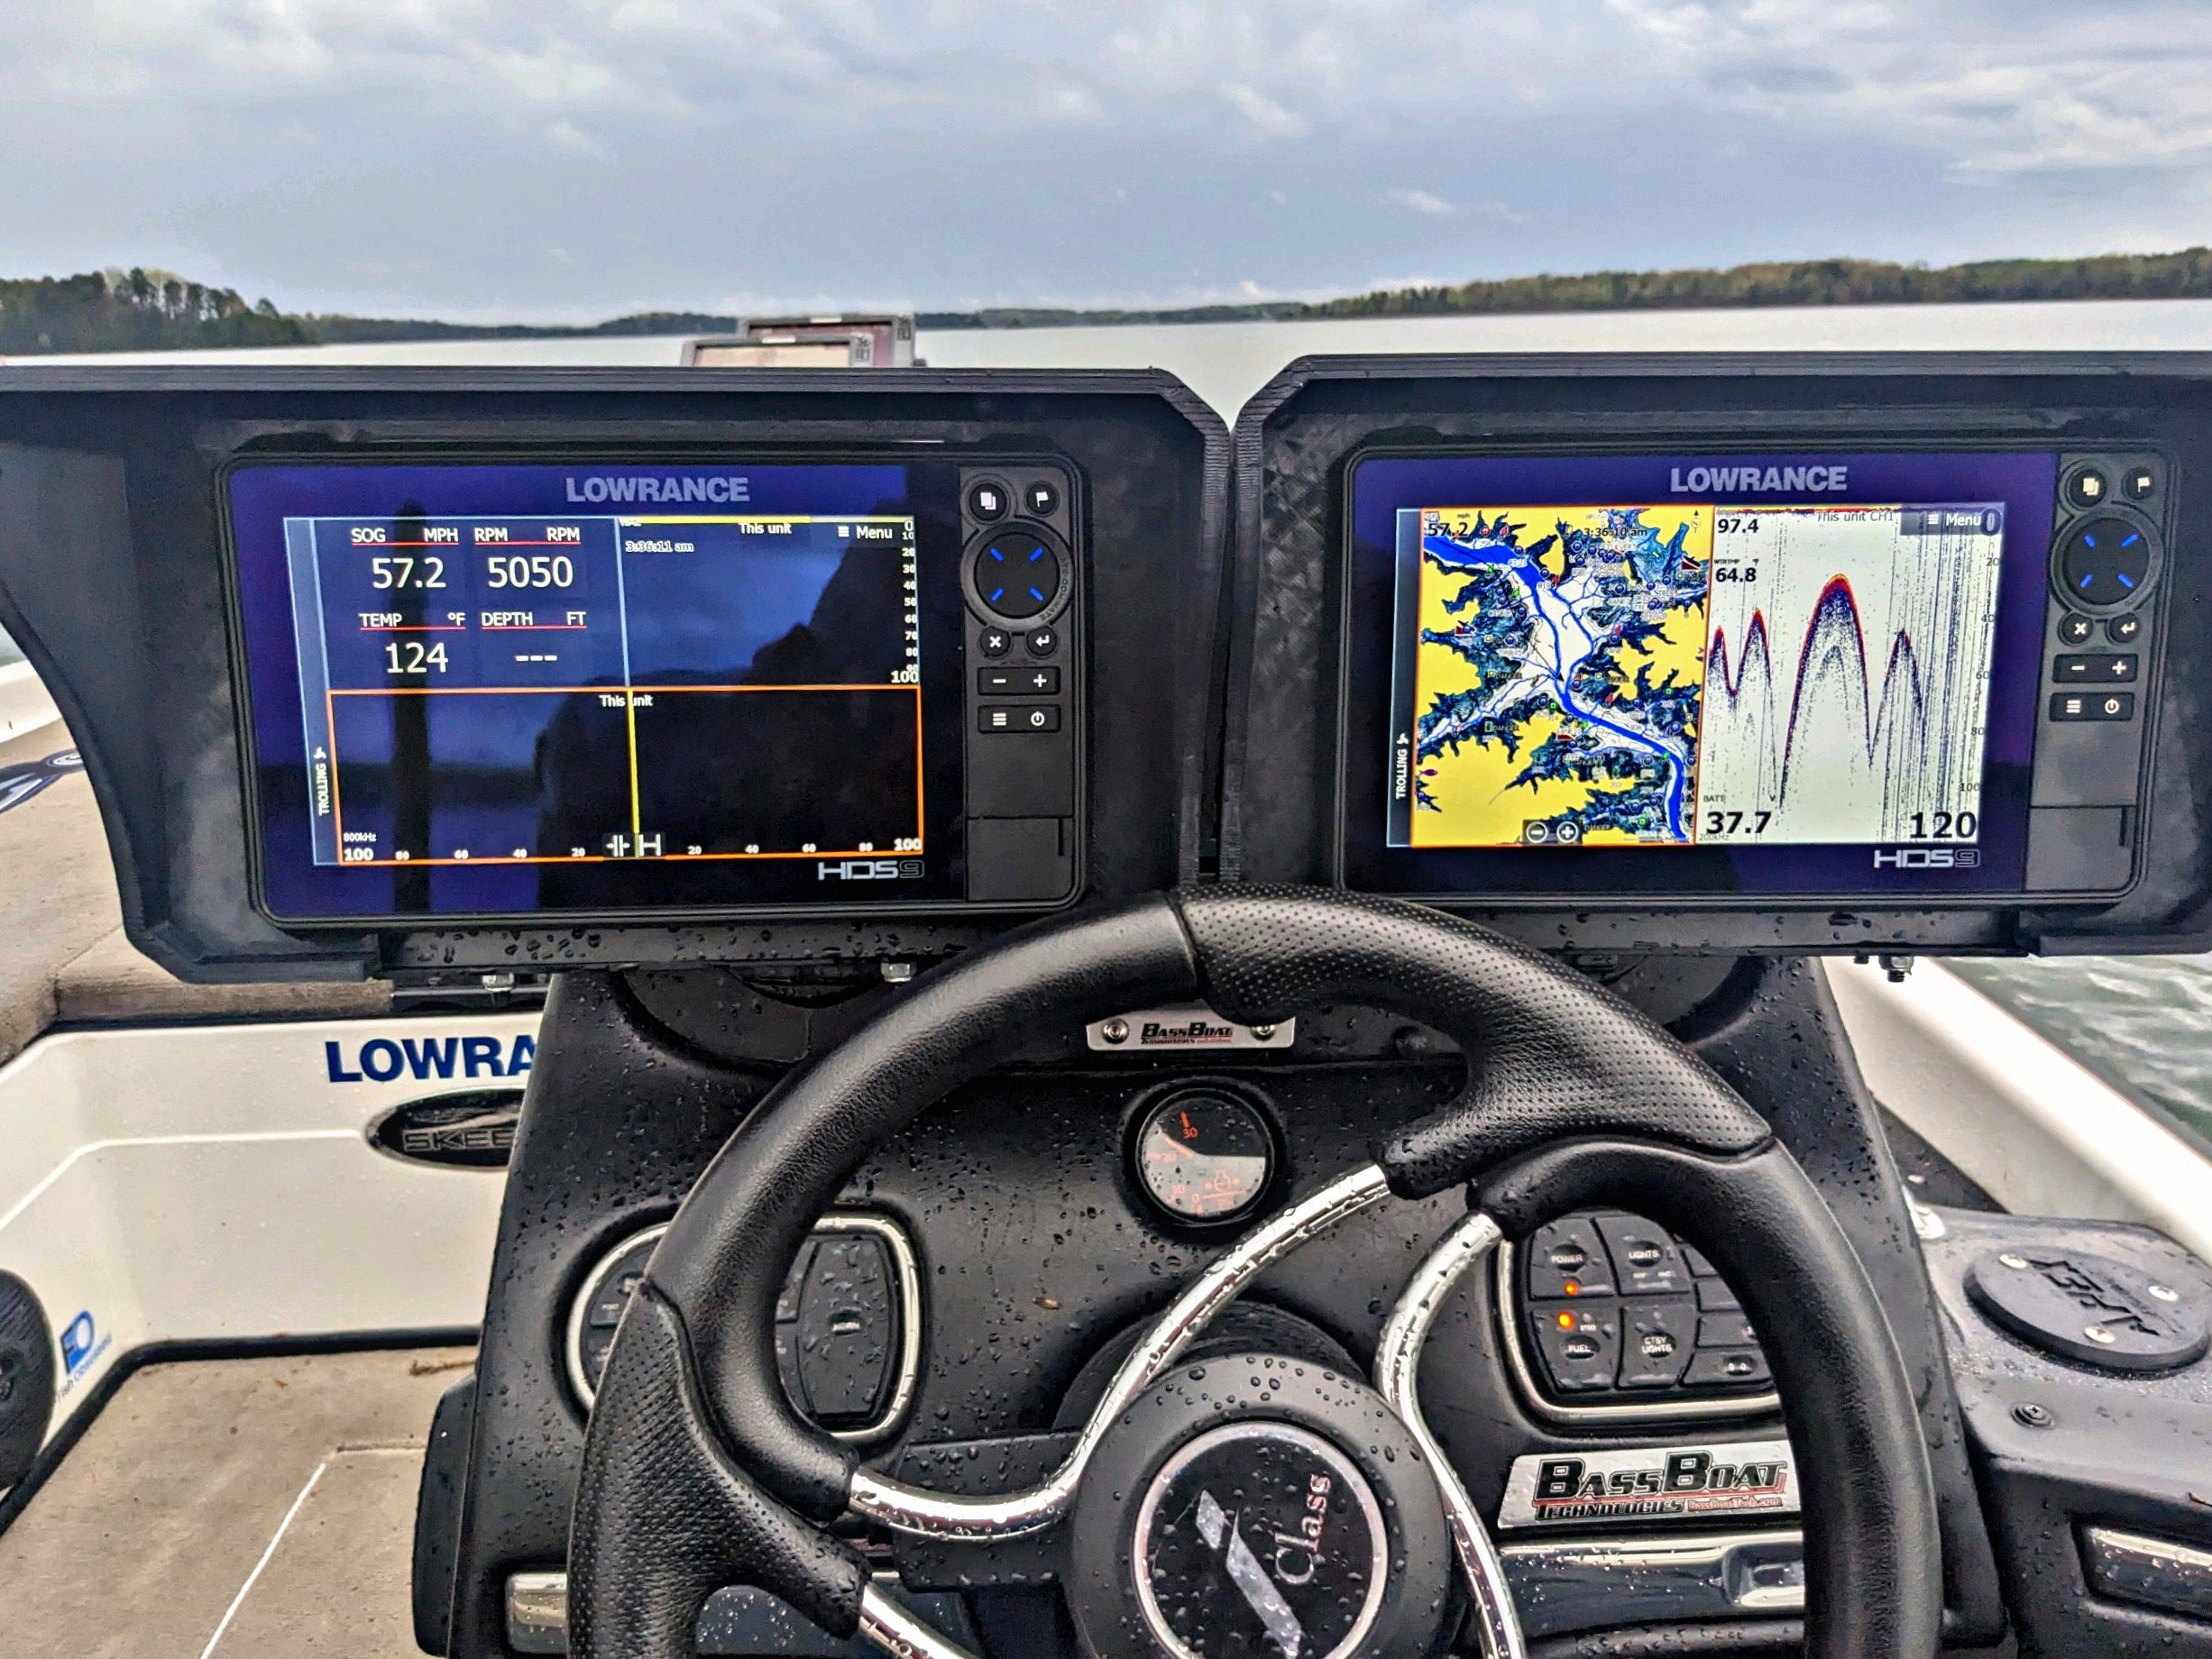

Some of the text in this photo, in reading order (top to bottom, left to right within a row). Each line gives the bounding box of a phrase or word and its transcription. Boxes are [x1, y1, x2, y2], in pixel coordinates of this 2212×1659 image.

[1671, 466, 1848, 492] LOWRANCE
[565, 476, 750, 503] LOWRANCE
[1817, 511, 1895, 522] This unit CH1
[1945, 512, 1982, 527] Menu
[739, 522, 793, 534] This unit
[904, 519, 914, 532] 0
[1717, 518, 1759, 534] 97.4
[351, 527, 459, 543] SOG MPH
[474, 527, 581, 543] RPM RPM
[856, 526, 893, 539] Menu
[902, 531, 914, 540] 10
[1630, 528, 1648, 537] am
[674, 542, 694, 553] am
[902, 547, 915, 557] 20
[1986, 556, 2000, 567] 20
[372, 556, 447, 589] 57.2
[487, 556, 574, 589] 5050
[903, 564, 915, 573] 30
[1715, 567, 1757, 582] 64.8
[903, 581, 916, 590] 40
[904, 597, 917, 607] 50
[358, 612, 466, 628] TEMP °F
[481, 611, 586, 628] DEPTH FT
[904, 614, 918, 624] 60
[904, 631, 918, 640] 70
[385, 642, 449, 674] 124
[905, 647, 919, 656] 80
[890, 670, 920, 683] 100
[600, 694, 653, 707] This unit
[1395, 748, 1409, 800] TROLLING
[316, 763, 330, 816] TROLLING
[1960, 782, 1980, 792] 100
[1703, 794, 1726, 802] BATT
[1705, 811, 1772, 835] 37.7
[1909, 811, 1977, 839] 120
[344, 831, 377, 843] 800kHz
[344, 848, 374, 862] 100
[454, 849, 469, 859] 60
[513, 848, 528, 858] 40
[571, 847, 585, 857] 20
[687, 845, 702, 856] 20
[745, 844, 759, 855] 40
[802, 843, 817, 854] 60
[893, 837, 922, 851] 100
[1873, 848, 1981, 868] HDS9
[817, 859, 925, 881] HDS9
[325, 1034, 537, 1083] LOWRA
[1182, 1127, 1198, 1140] 30
[1550, 1254, 1583, 1264] POWER
[1628, 1250, 1659, 1260] LIGHTS
[1644, 1336, 1667, 1344] CTSY
[1568, 1343, 1592, 1353] FUEL
[1641, 1343, 1673, 1354] LIGHTS
[1534, 1498, 1686, 1521] TECHNOLOGIES
[1274, 1471, 1332, 1585] Class
